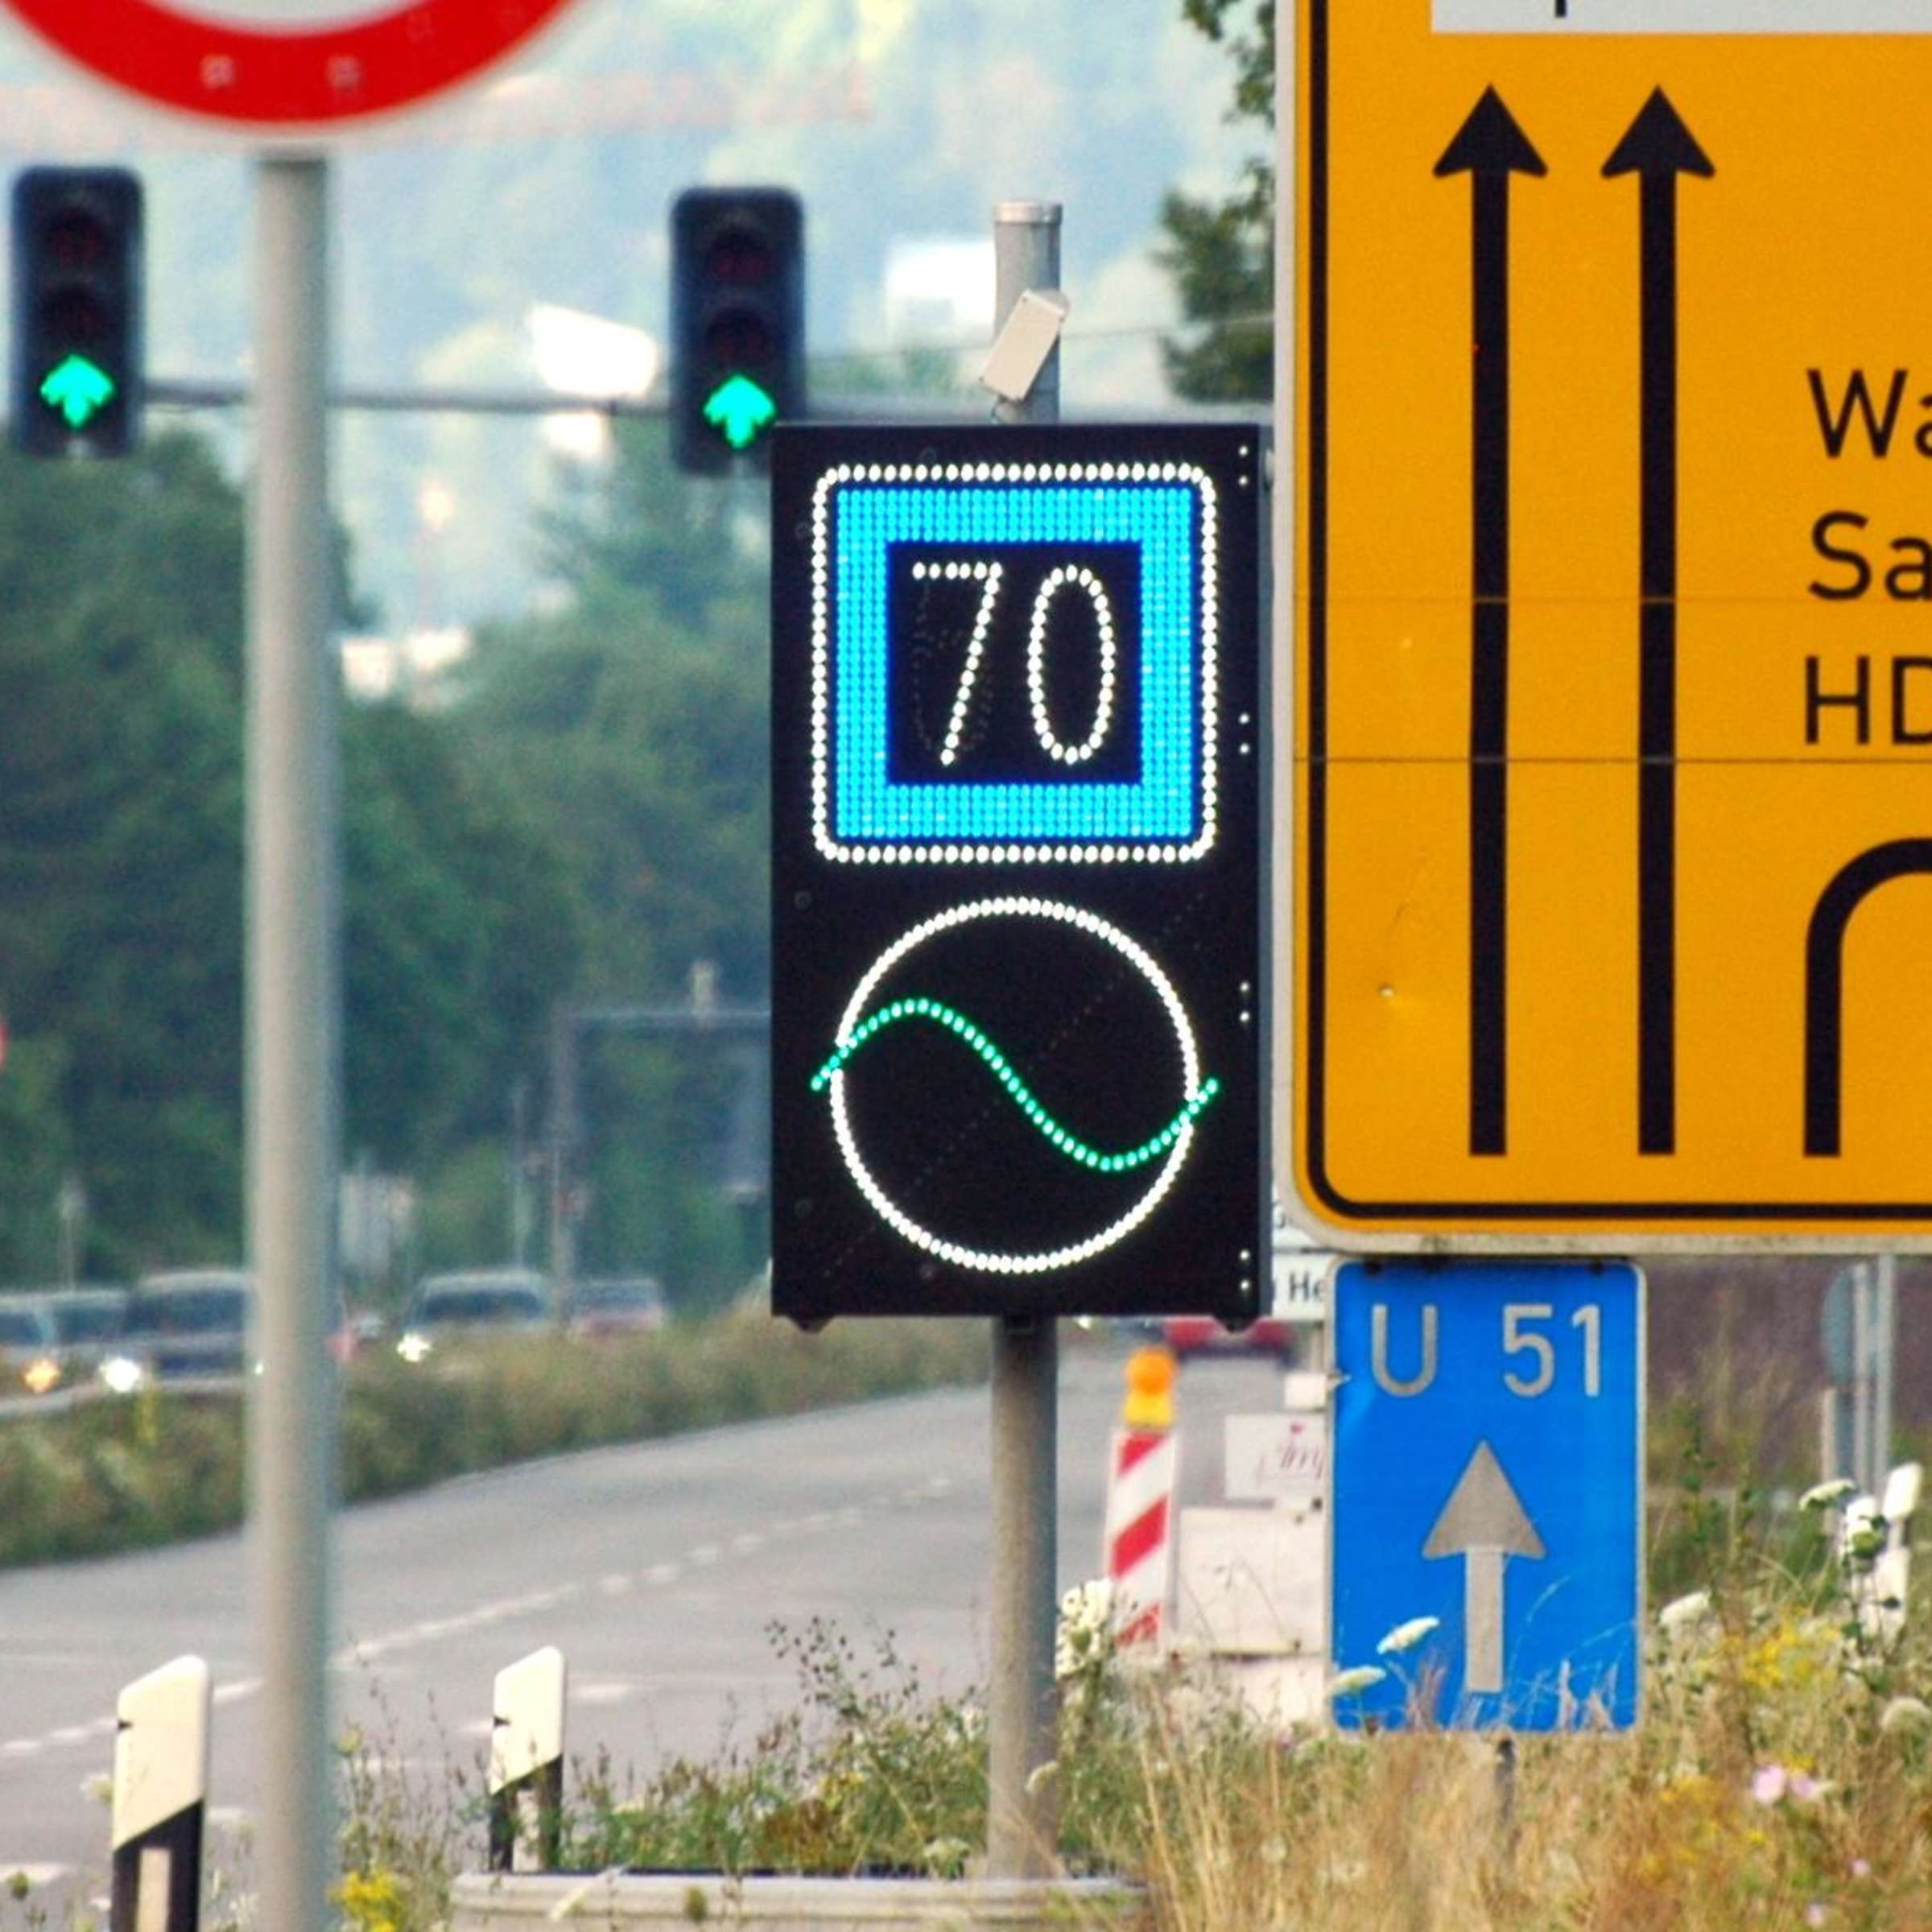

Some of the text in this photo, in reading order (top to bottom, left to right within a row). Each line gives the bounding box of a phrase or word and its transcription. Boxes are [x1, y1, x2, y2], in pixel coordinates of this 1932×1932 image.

[1808, 510, 1932, 601] Sa
[913, 561, 1116, 766] 70
[1804, 654, 1932, 745] HD
[1372, 1304, 1600, 1397] U 51
